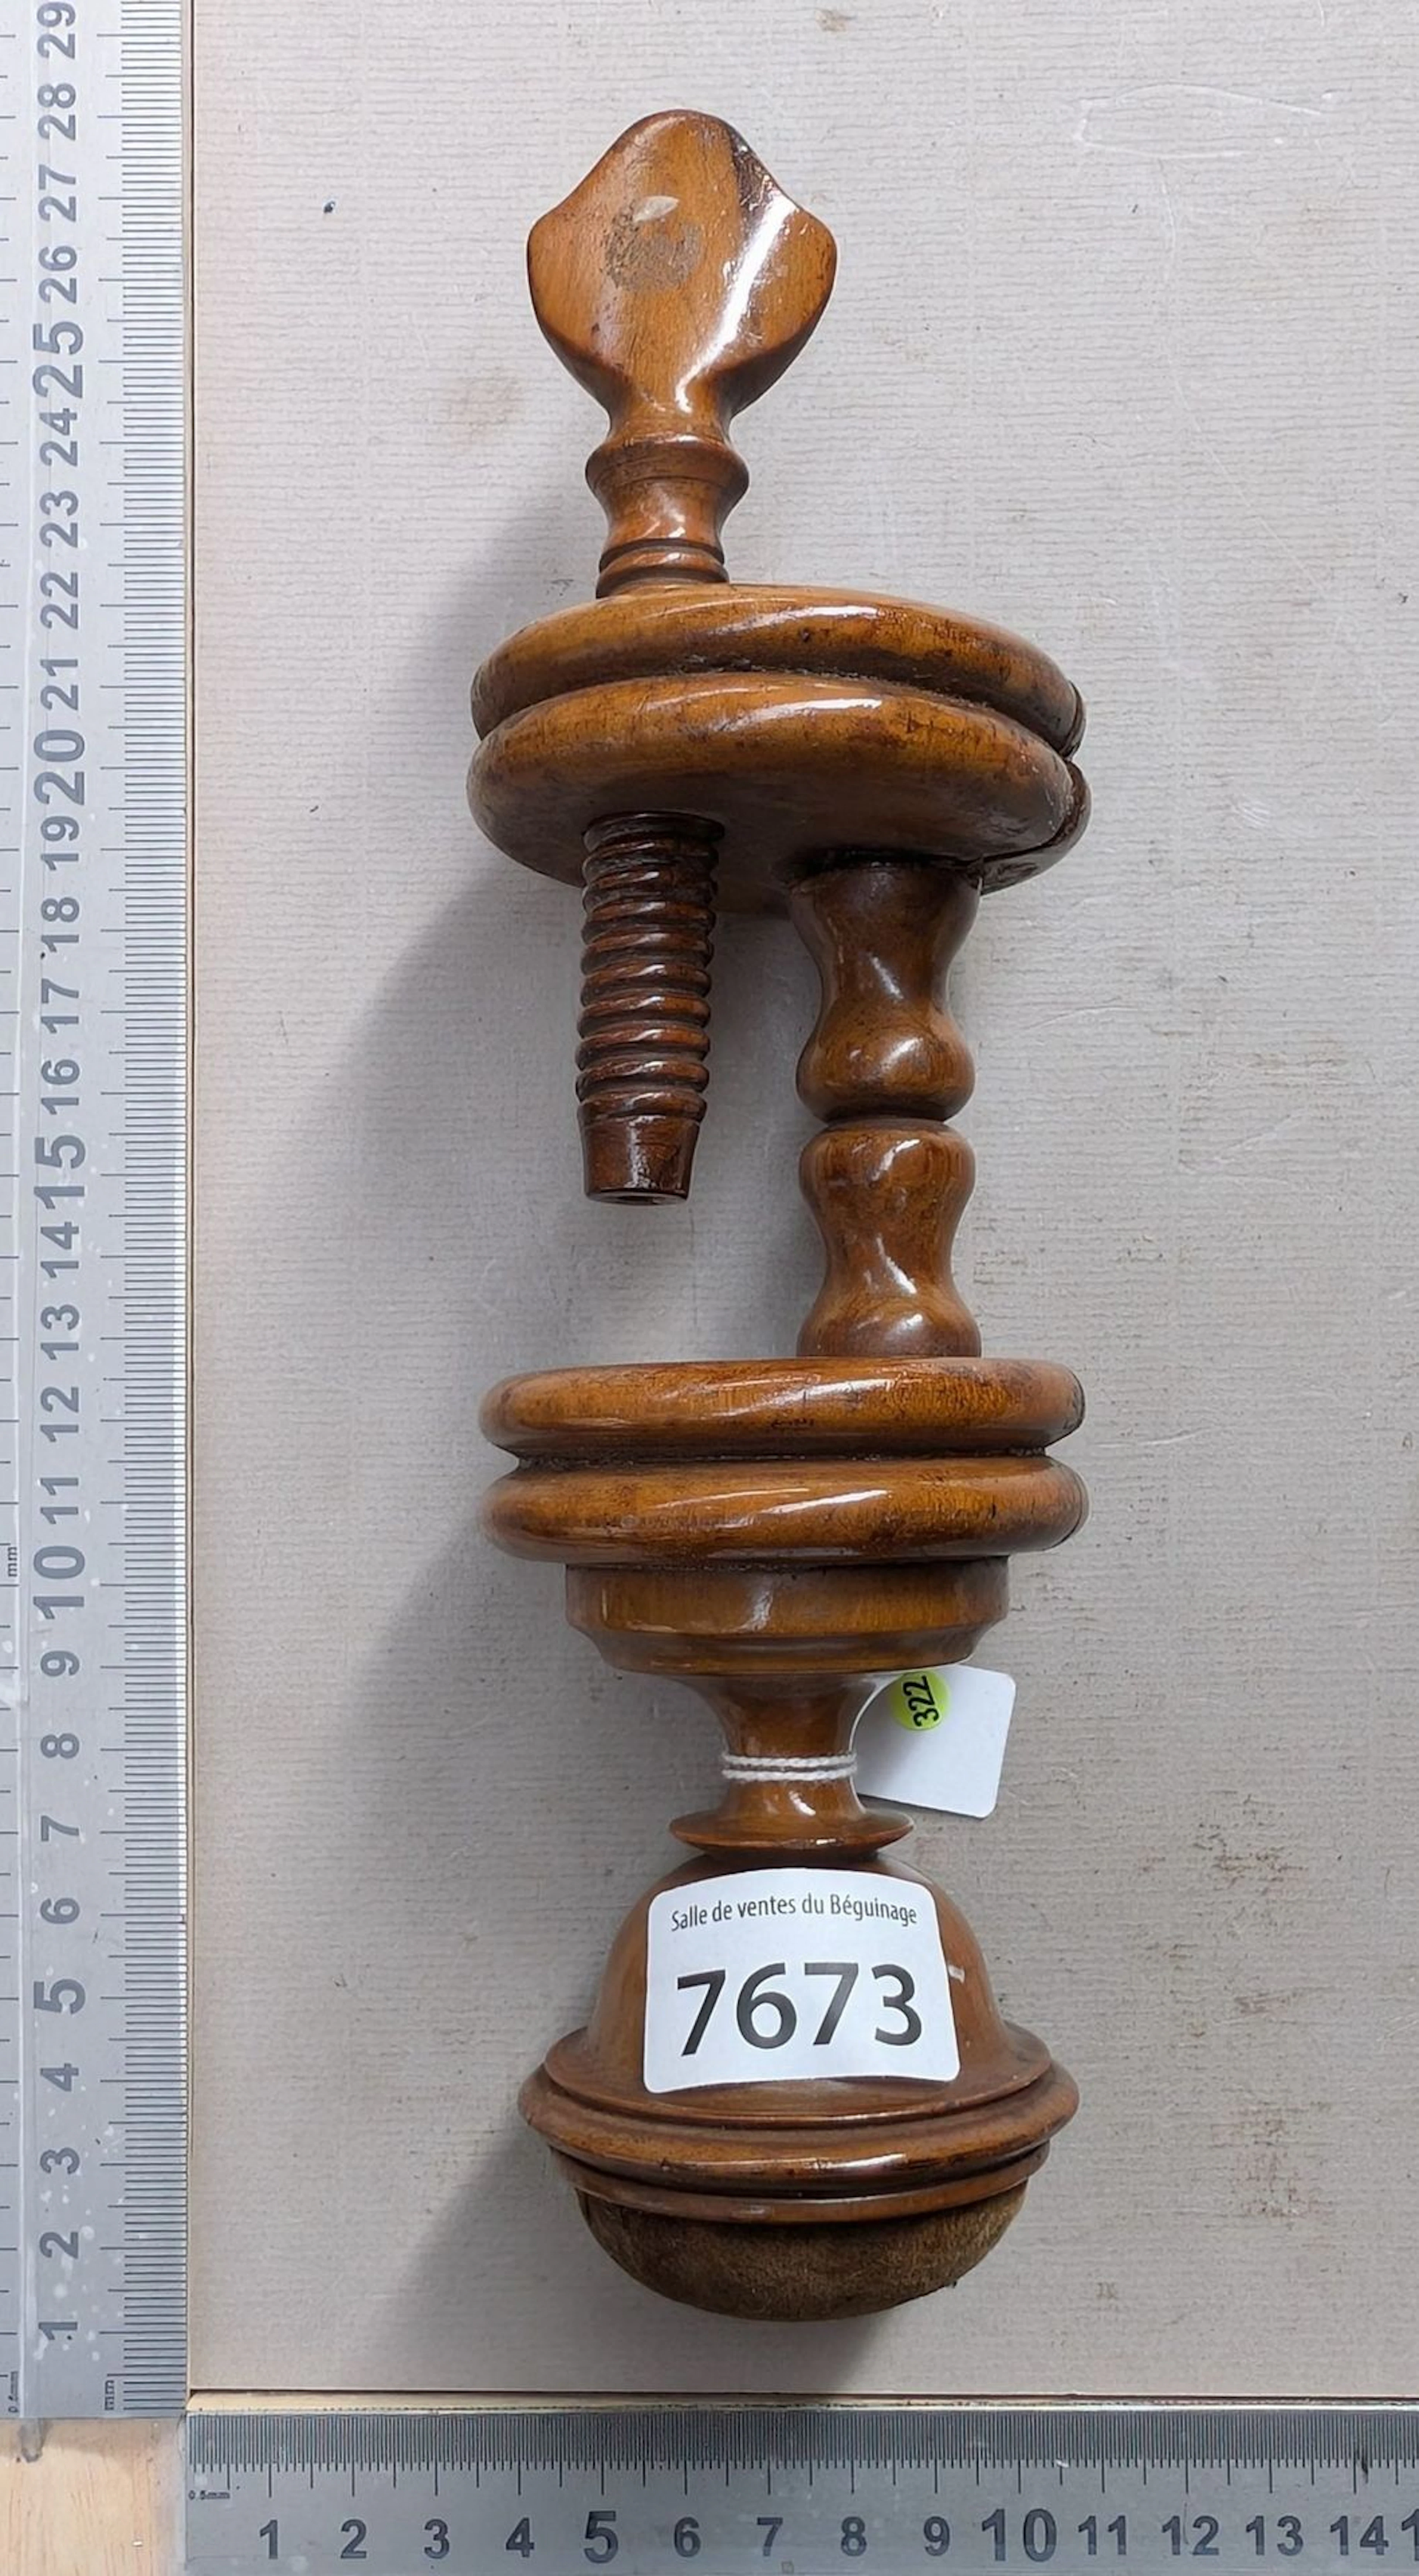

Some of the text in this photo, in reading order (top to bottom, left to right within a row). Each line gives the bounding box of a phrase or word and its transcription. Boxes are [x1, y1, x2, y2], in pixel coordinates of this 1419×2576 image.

[33, 2, 85, 2341] 1 2 3 4 5 6 7 8 9 10 11 12 13 14 15 16 17 18 19 20 21 22 23 24 25 26 27 28 29
[7, 1547, 17, 1577] mm
[902, 1675, 939, 1727] 322
[671, 1892, 917, 1932] Salle de ventes du Béguinage
[677, 1962, 922, 2057] 7673
[259, 2519, 278, 2559] 1
[340, 2519, 367, 2559] 2
[424, 2519, 450, 2559] 3
[506, 2518, 534, 2558] 4
[584, 2511, 618, 2563] 5
[674, 2517, 701, 2557] 6
[756, 2517, 783, 2556] 7
[841, 2516, 867, 2556] 8
[923, 2516, 950, 2556] 9
[981, 2510, 1056, 2562] 10
[1078, 2515, 1126, 2555] 11
[1161, 2515, 1219, 2556] 12
[1246, 2515, 1303, 2556] 13
[1330, 2515, 1389, 2556] 14
